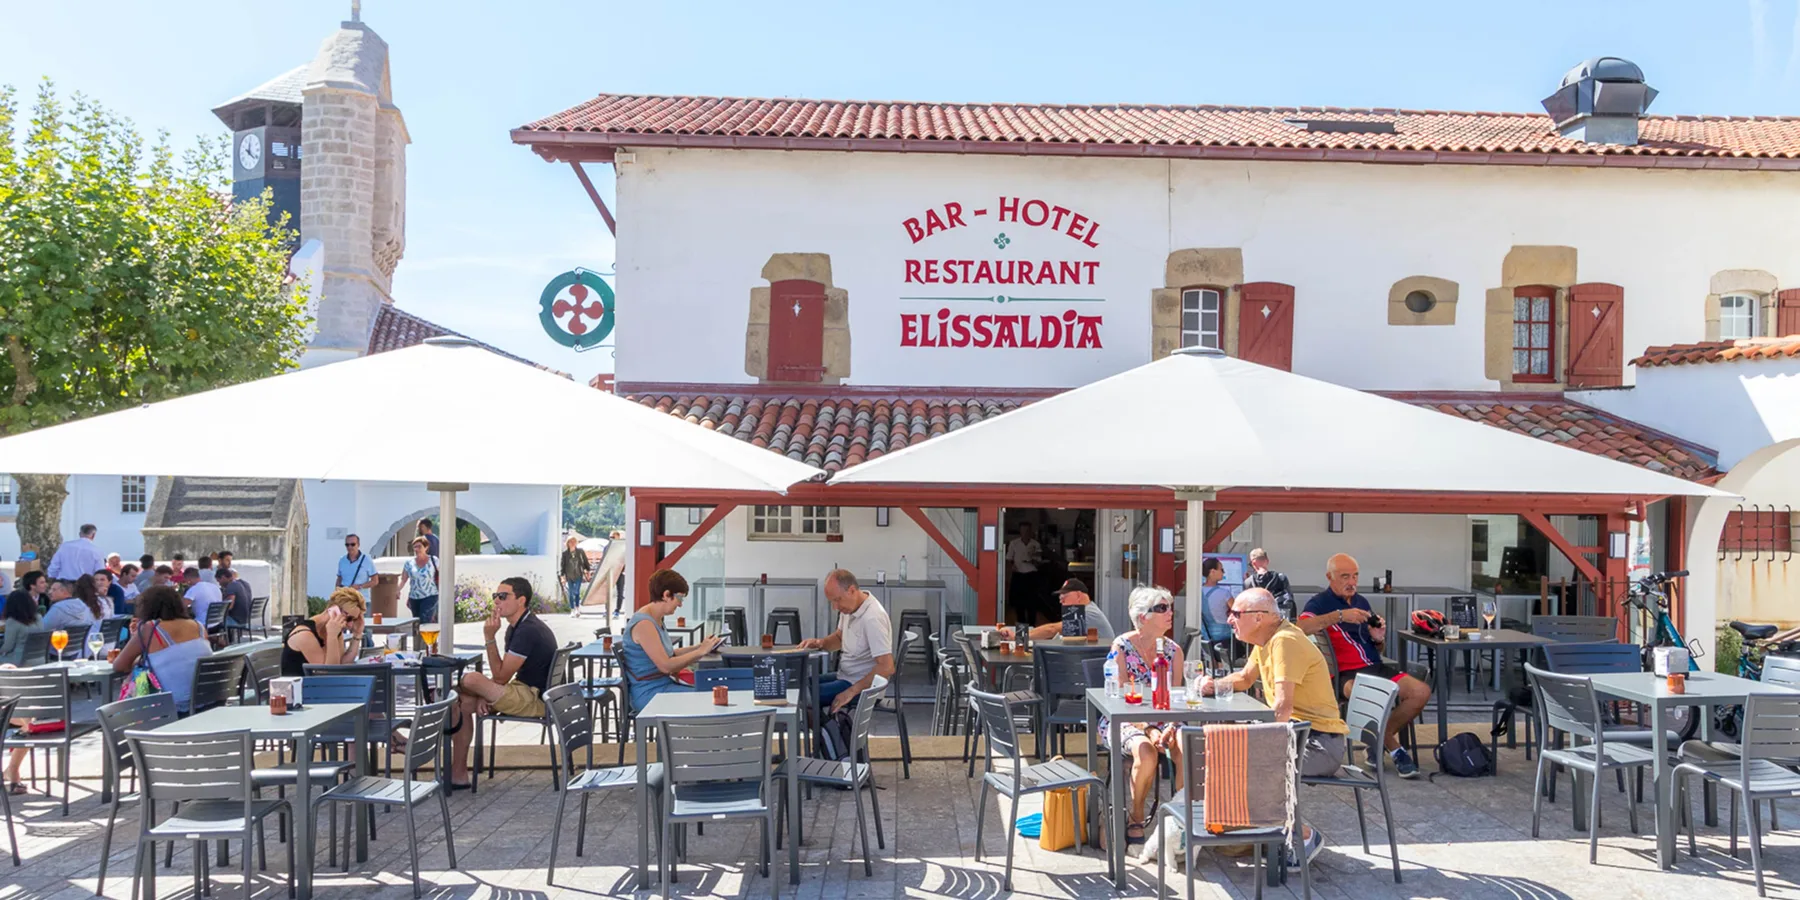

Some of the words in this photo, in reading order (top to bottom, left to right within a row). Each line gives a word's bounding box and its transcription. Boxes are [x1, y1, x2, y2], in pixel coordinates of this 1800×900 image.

[902, 202, 967, 244] BAR
[999, 197, 1100, 248] HOTEL
[904, 260, 1100, 285] RESTAURANT
